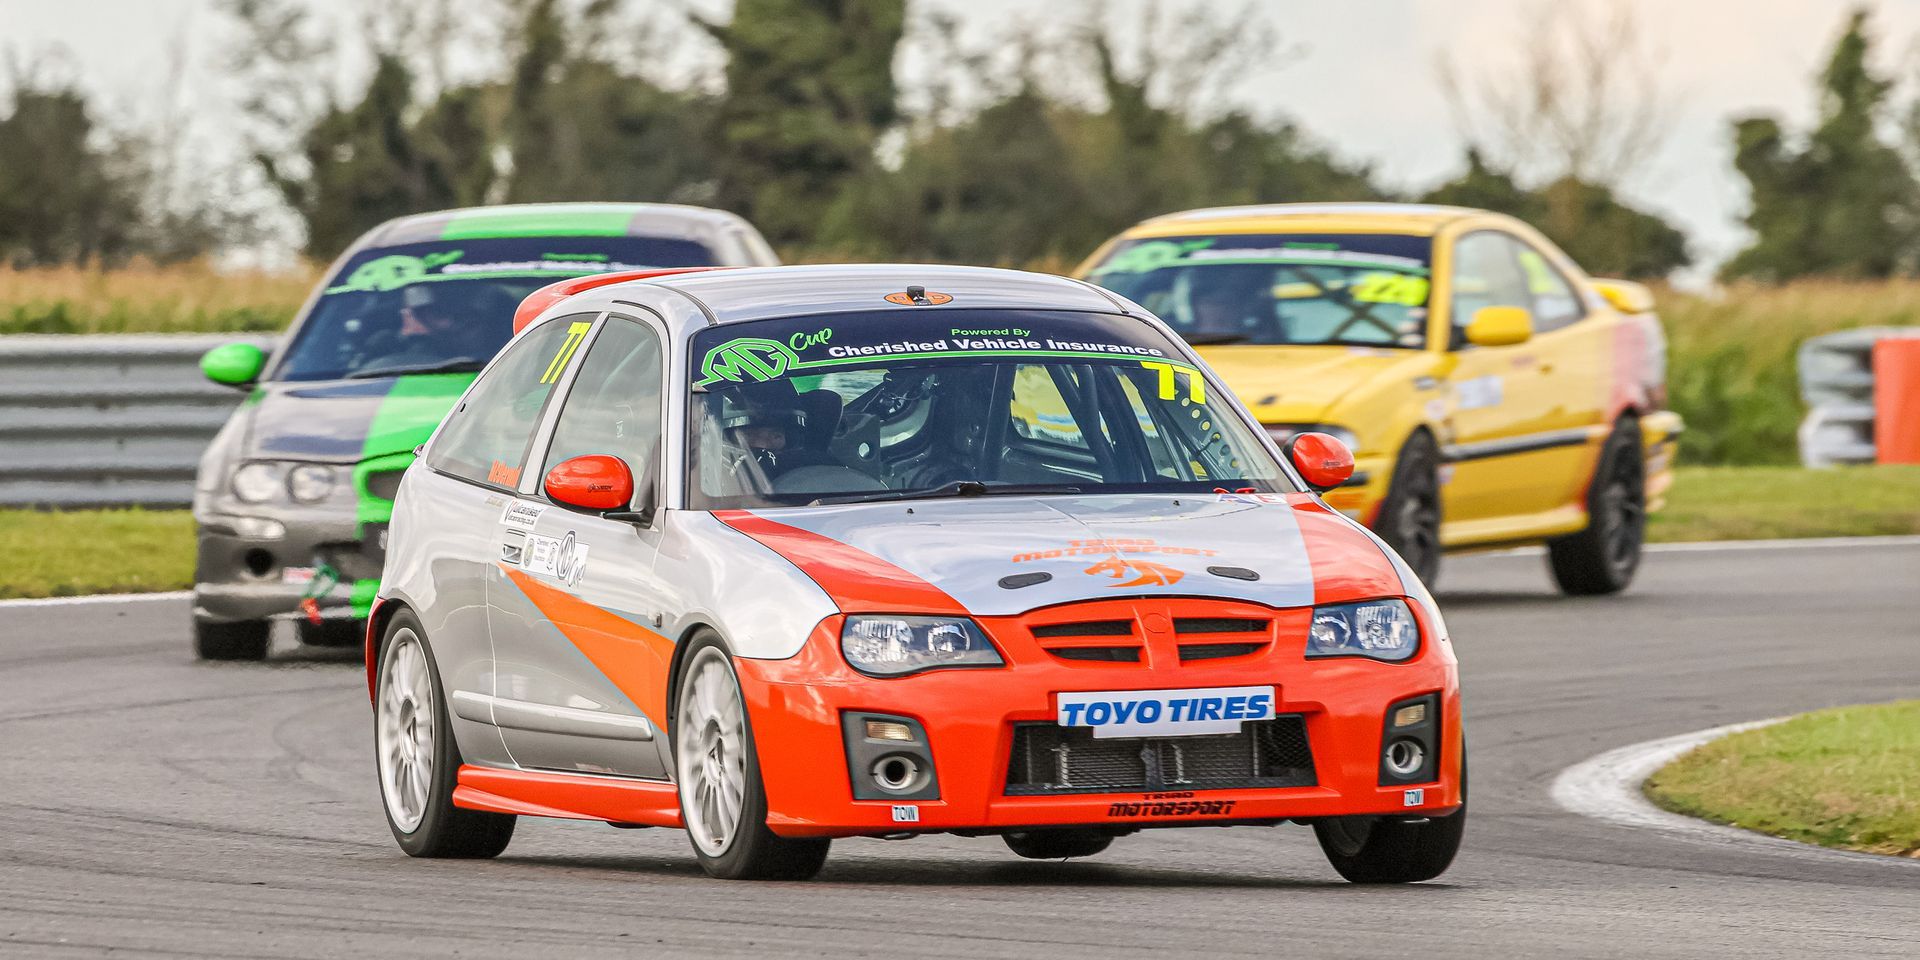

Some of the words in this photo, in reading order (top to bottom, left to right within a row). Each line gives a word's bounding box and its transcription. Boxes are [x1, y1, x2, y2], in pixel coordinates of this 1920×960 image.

[951, 328, 1009, 337] Powered
[1013, 328, 1031, 337] By
[540, 322, 592, 384] 77
[705, 340, 795, 384] MG
[789, 328, 832, 351] Cup
[829, 339, 948, 358] Cherished
[953, 338, 1042, 350] Vehicle
[1046, 338, 1163, 357] Insurance
[1140, 361, 1206, 405] 77
[1062, 700, 1161, 726] TOYO
[1168, 695, 1270, 722] TIRES
[893, 806, 916, 820] TOW
[1108, 801, 1237, 817] MOTORSPORT
